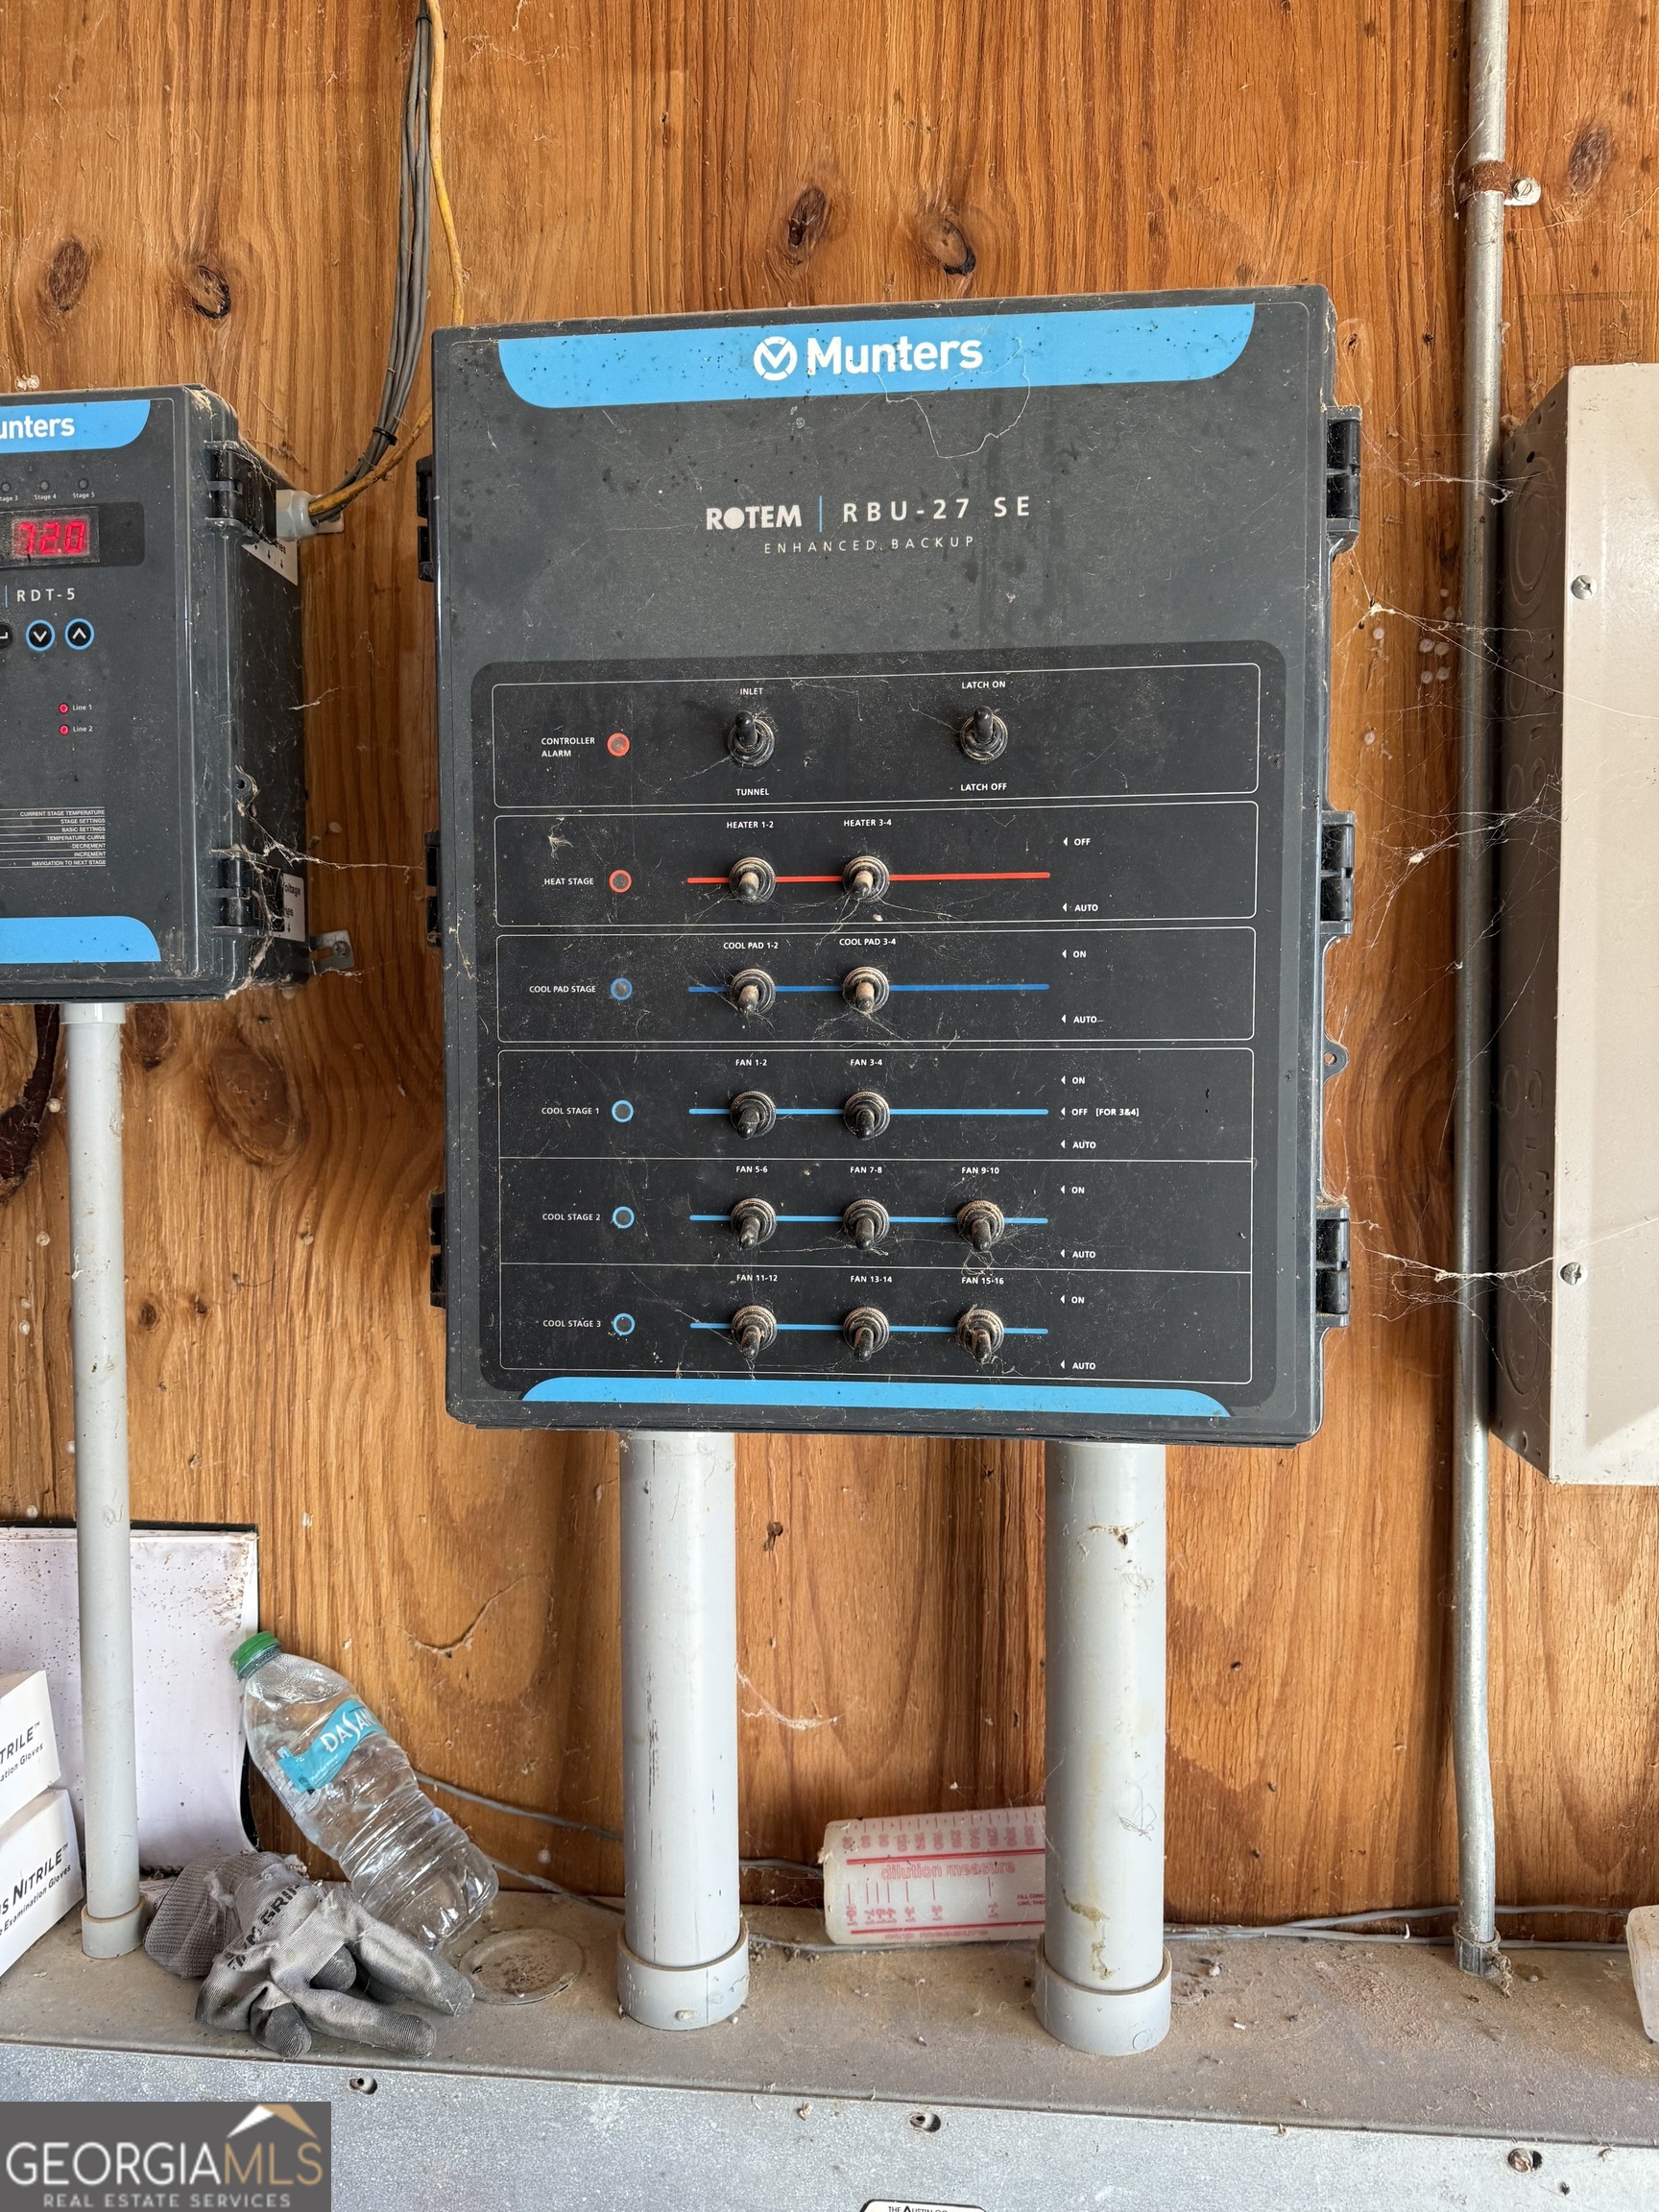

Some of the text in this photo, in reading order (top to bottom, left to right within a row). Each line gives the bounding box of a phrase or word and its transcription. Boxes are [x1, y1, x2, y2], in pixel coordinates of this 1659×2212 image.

[806, 335, 983, 376] Munters
[843, 495, 1029, 523] RBU-27 SE
[706, 504, 803, 531] ROTEM
[18, 521, 85, 554] 72.0
[764, 535, 974, 554] ENHANCED BACKUP
[16, 588, 76, 602] RDT-5
[961, 680, 1006, 689] LATCH ON
[541, 736, 595, 746] CONTROLLER
[541, 749, 572, 757] ALARM
[735, 787, 770, 796] TUNNEL
[960, 782, 1007, 792] LATCH OFF
[726, 820, 774, 830] HEATER 1-2
[843, 818, 892, 828] HEATER 3-4
[1073, 837, 1091, 846] OFF
[1074, 903, 1099, 912] AUTO
[766, 941, 779, 950] 1-2
[838, 937, 897, 947] COOL PAD 3-4
[1072, 950, 1087, 958] ON
[529, 985, 552, 994] COOL
[1072, 1015, 1097, 1023] AUTO
[735, 1058, 767, 1067] FAN 1-2
[850, 1058, 883, 1067] FAN 3-4
[1071, 1076, 1086, 1085] ON
[595, 1107, 600, 1116] 1
[1071, 1107, 1140, 1118] OFF [FOR 3&4]
[1072, 1141, 1096, 1149] AUTO
[868, 1166, 882, 1174] 7-8
[980, 1166, 1000, 1175] 9-10
[1071, 1186, 1085, 1194] ON
[541, 1213, 602, 1221] COOL STAGE 2
[1071, 1250, 1096, 1259] AUTO
[870, 1275, 893, 1284] 13-14
[961, 1276, 1004, 1286] FAN 15-16
[1070, 1295, 1085, 1304] ON
[542, 1319, 602, 1328] COOL STAGE 3
[1071, 1361, 1096, 1370] AUTO
[20, 1743, 43, 1766] Gloves
[881, 1861, 1016, 1880] dilution measure
[4, 1864, 71, 1932] Examination Gloves
